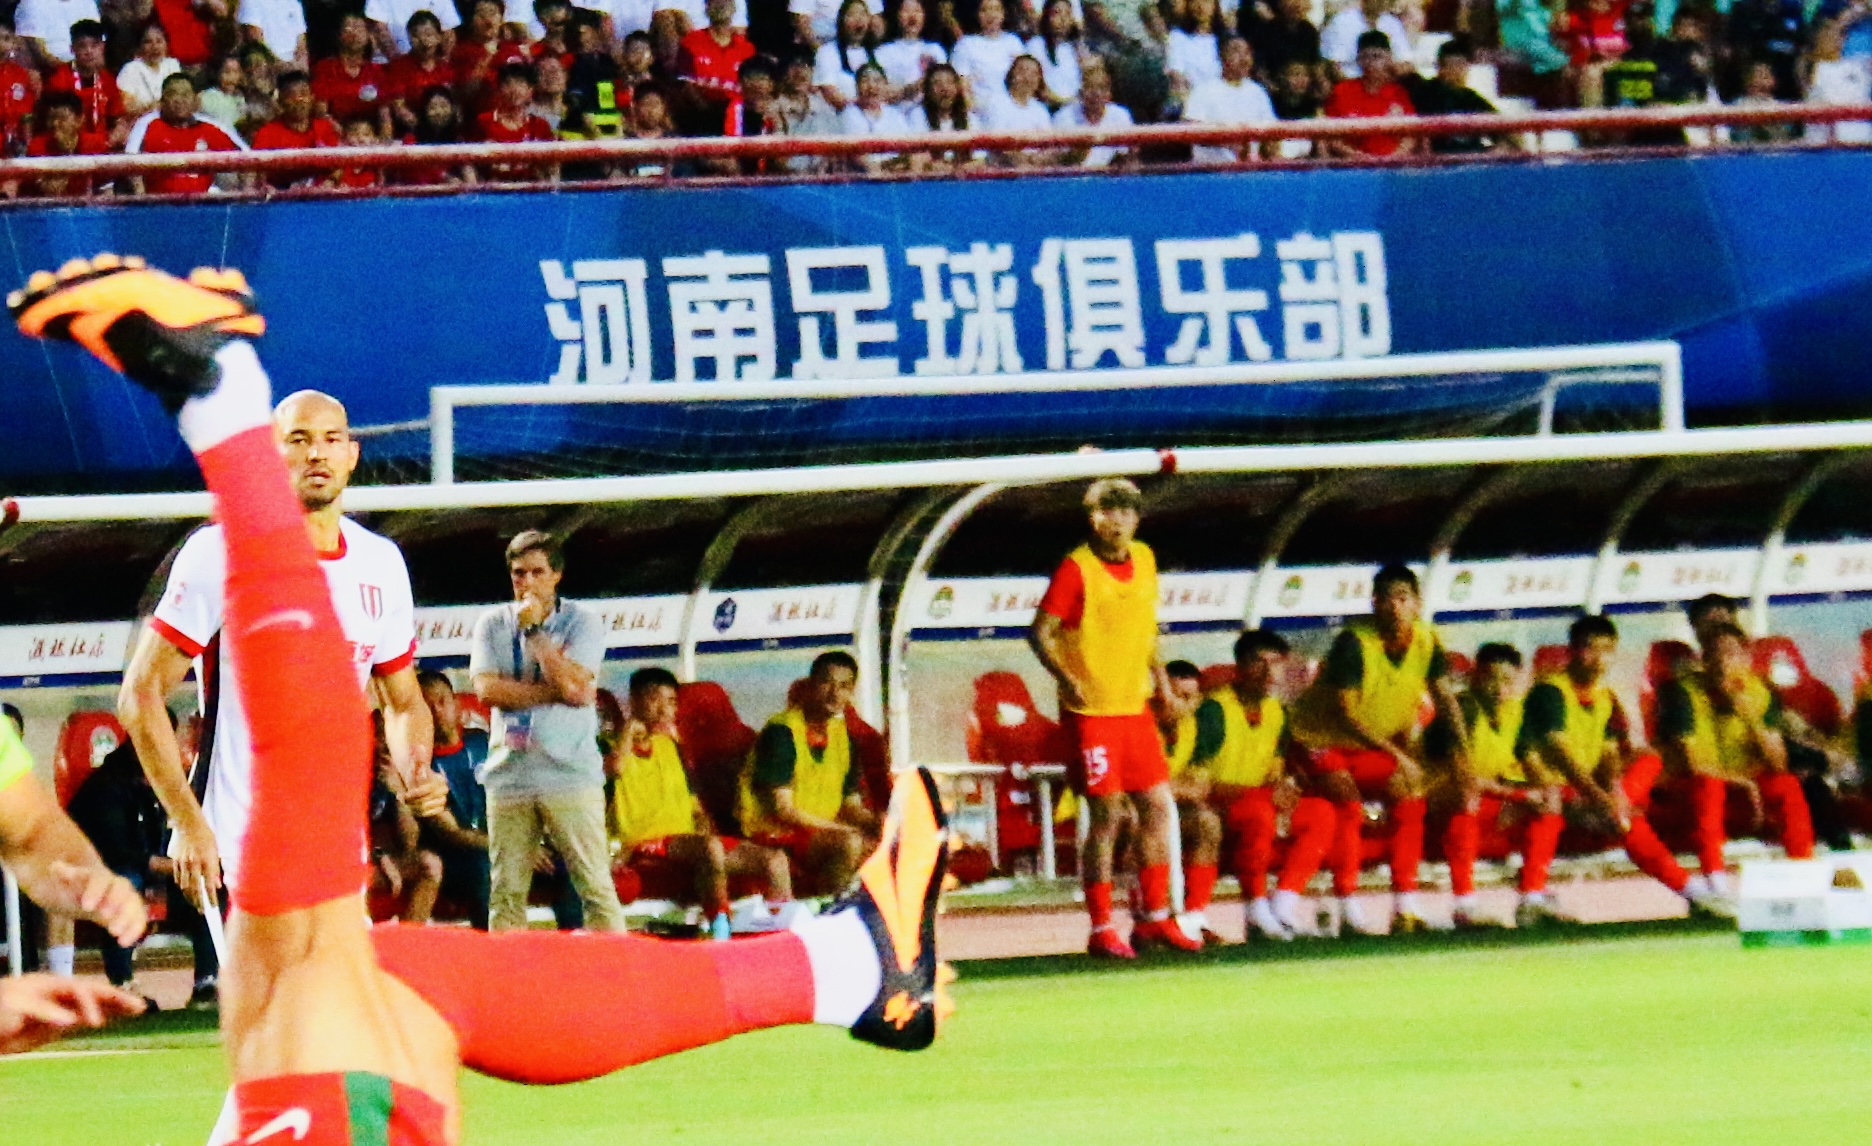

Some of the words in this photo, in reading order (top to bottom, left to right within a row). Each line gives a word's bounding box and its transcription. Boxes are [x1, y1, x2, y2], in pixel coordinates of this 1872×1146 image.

[539, 231, 1392, 385] 河南足球俱乐部
